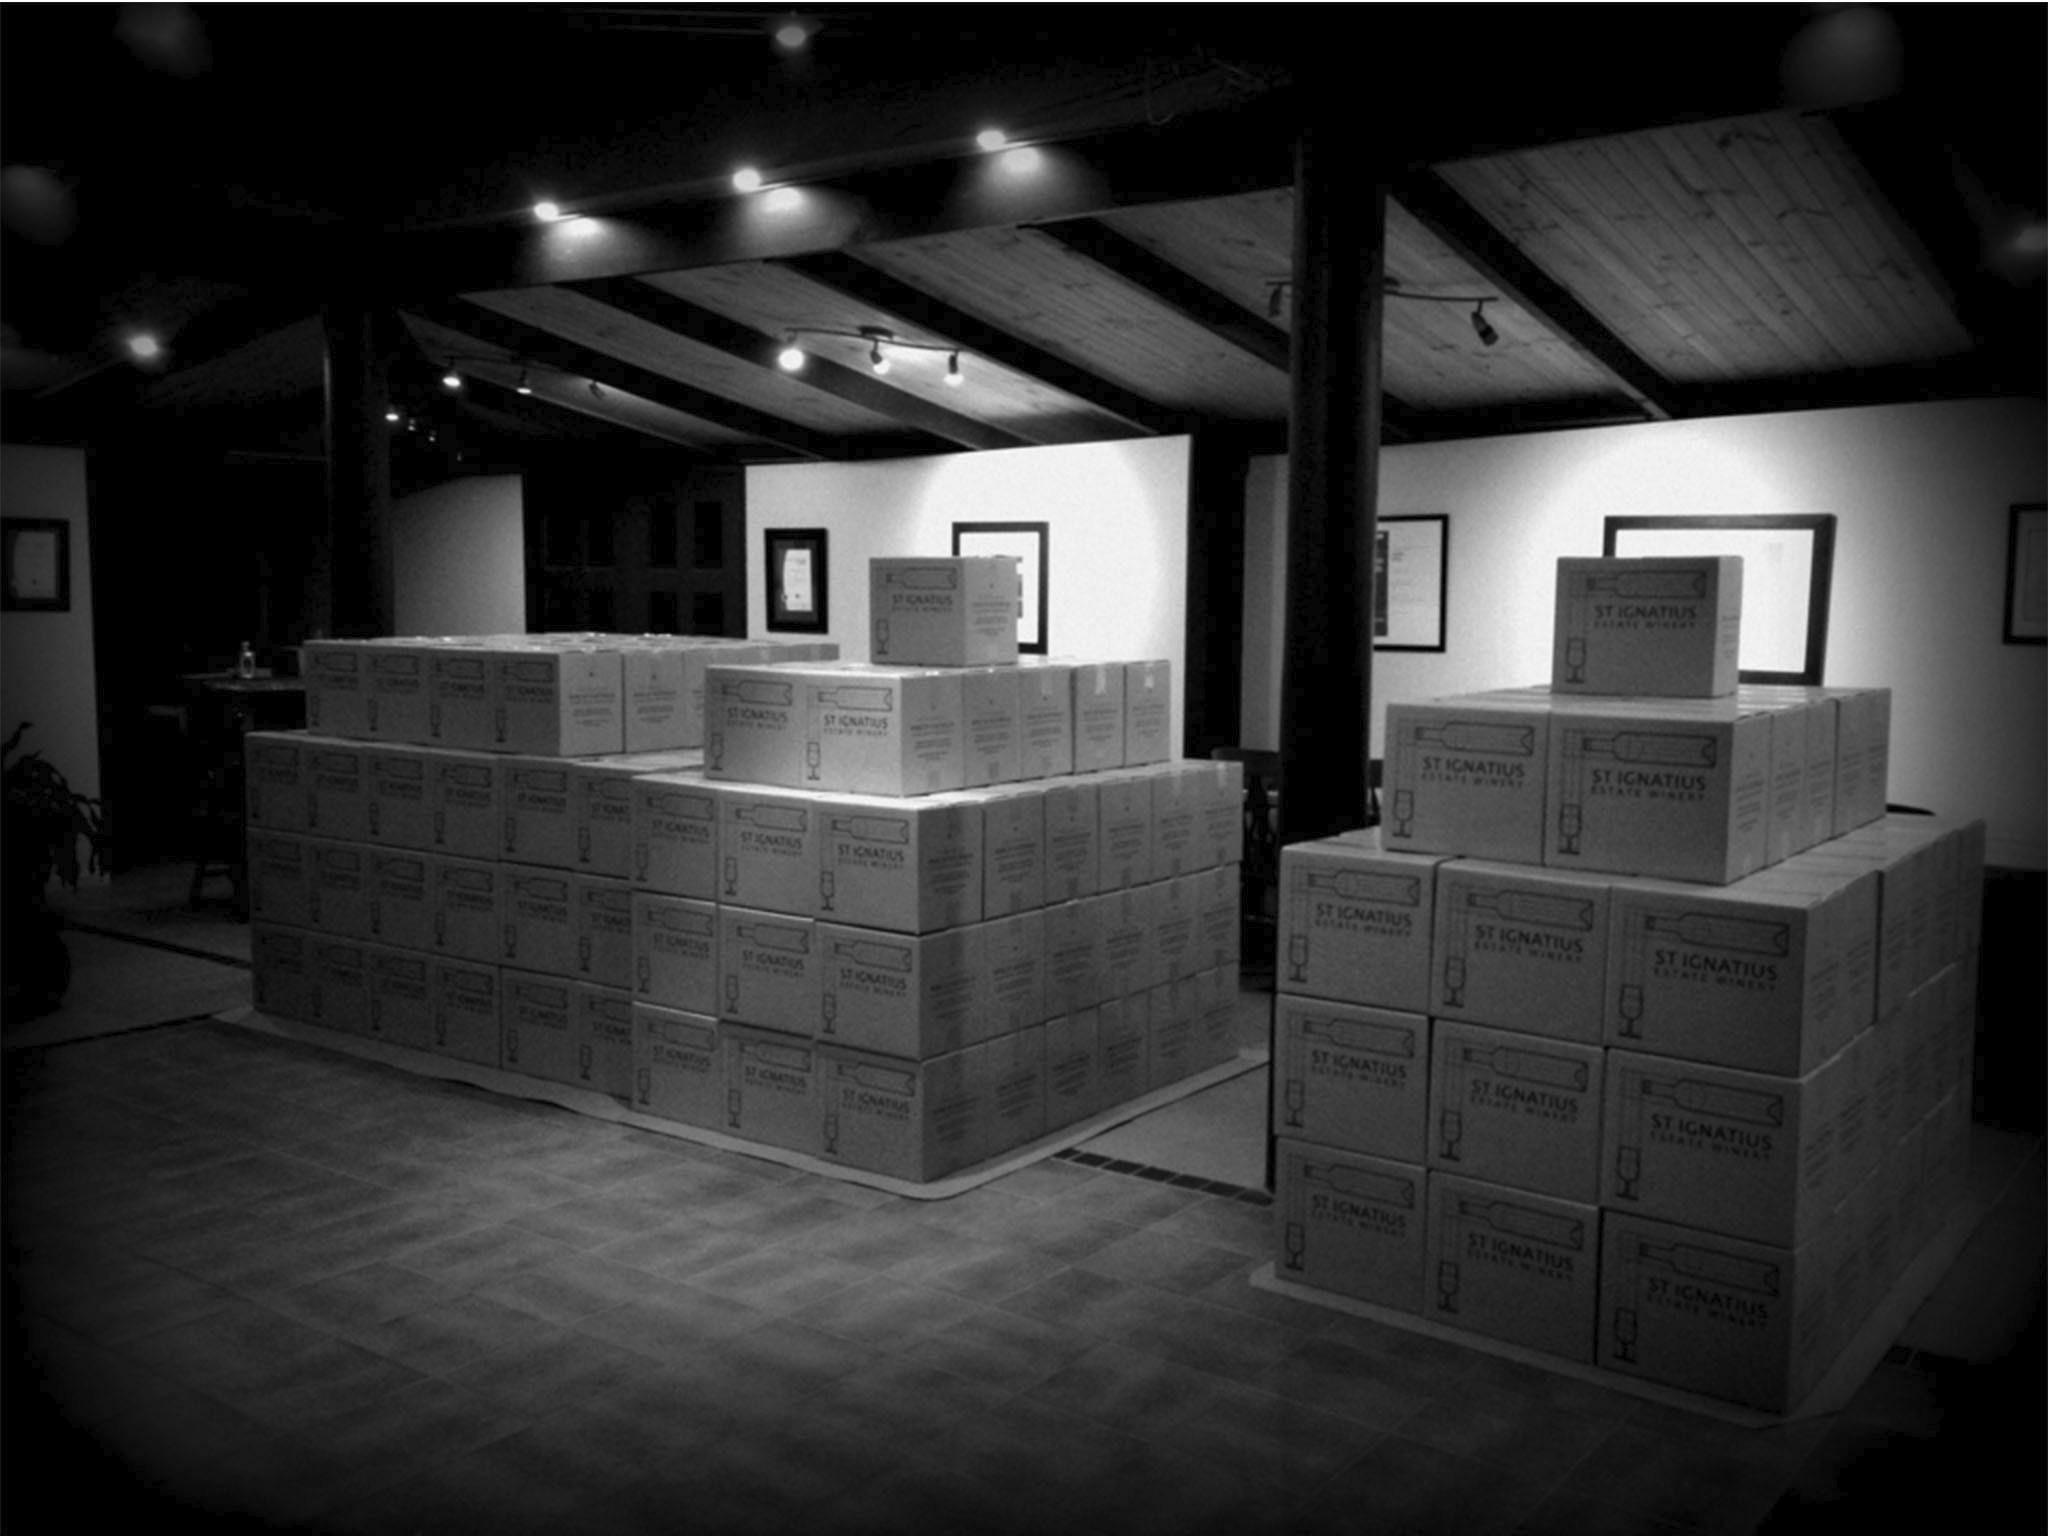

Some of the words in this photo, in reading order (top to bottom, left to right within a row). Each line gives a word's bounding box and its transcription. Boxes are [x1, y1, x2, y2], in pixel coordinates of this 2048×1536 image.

[1594, 605, 1612, 618] ST
[1618, 605, 1696, 620] IGNATIUS
[1422, 756, 1440, 770] ST
[1446, 760, 1525, 778] IGNATIUS
[1593, 769, 1610, 784] ST
[1618, 772, 1706, 791] IGNATIUS
[1316, 903, 1332, 917] ST
[1338, 906, 1412, 927] IGNATIUS
[1475, 925, 1494, 939] ST
[1501, 928, 1583, 953] IGNATIUS
[1655, 950, 1677, 965] ST
[1683, 953, 1777, 981] IGNATIUS
[1312, 1049, 1328, 1064] ST
[1334, 1055, 1407, 1079] IGNATIUS
[1471, 1078, 1489, 1093] ST
[1496, 1085, 1578, 1113] IGNATIUS
[1652, 1114, 1672, 1129] ST
[1679, 1119, 1772, 1151] IGNATIUS
[1312, 1194, 1329, 1209] ST
[1333, 1200, 1406, 1228] IGNATIUS
[1468, 1232, 1485, 1247] ST
[1492, 1240, 1574, 1272] IGNATIUS
[1650, 1279, 1668, 1295] ST
[1674, 1284, 1767, 1320] IGNATIUS
